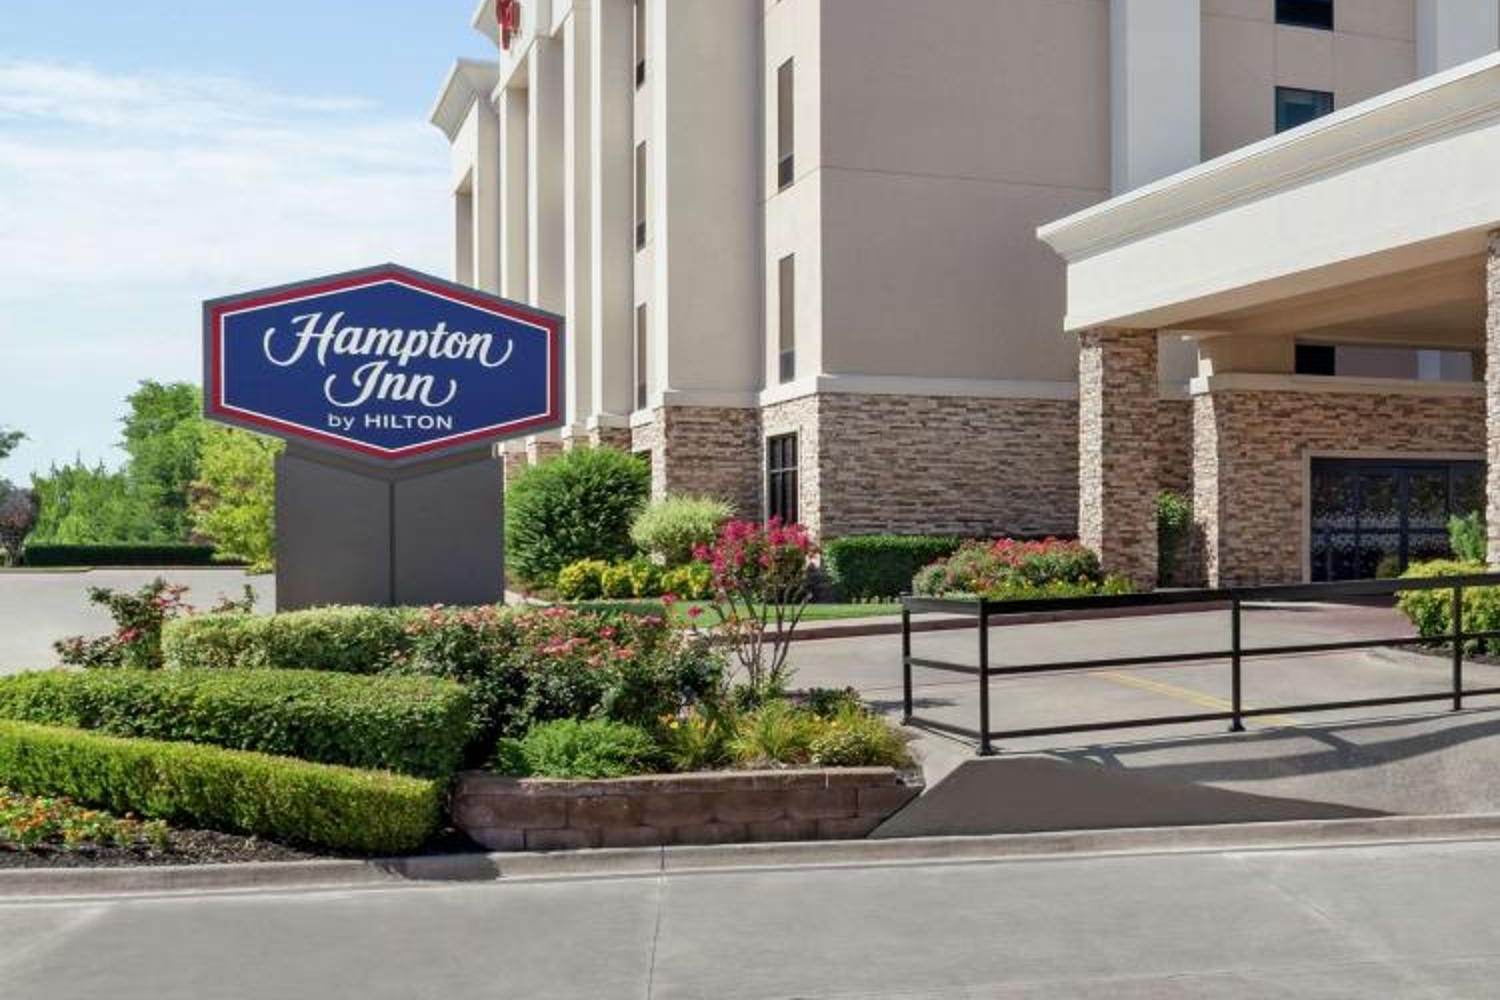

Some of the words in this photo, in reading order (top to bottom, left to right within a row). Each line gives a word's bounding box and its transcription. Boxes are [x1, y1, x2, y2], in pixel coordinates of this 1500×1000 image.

[263, 311, 513, 367] Hampton
[324, 360, 457, 407] Inn
[327, 412, 355, 431] by
[364, 414, 453, 429] HILTON
